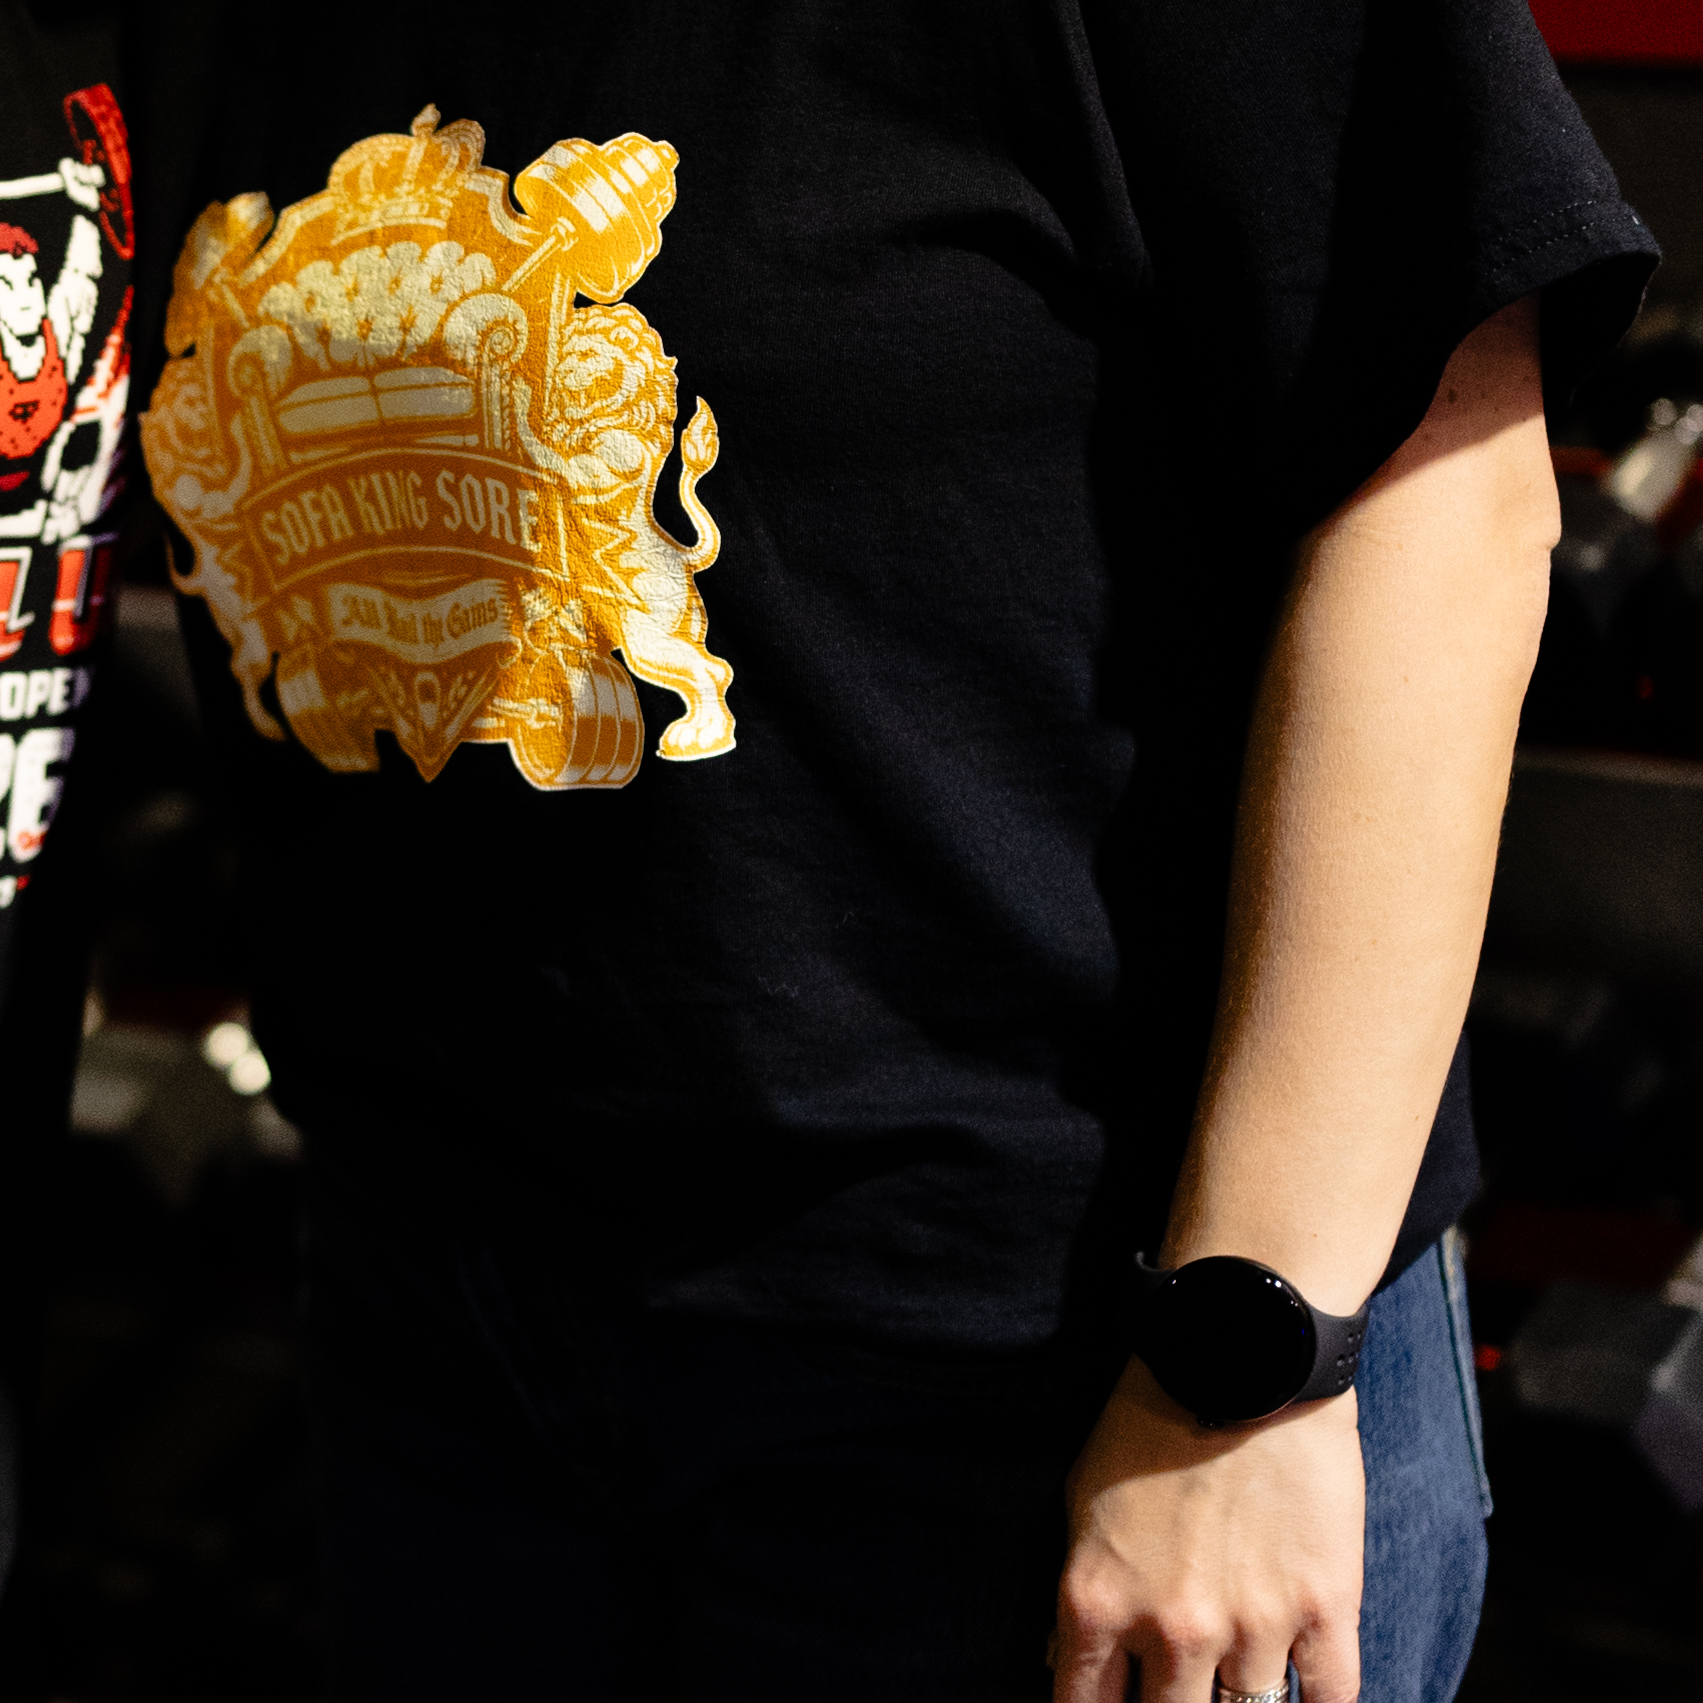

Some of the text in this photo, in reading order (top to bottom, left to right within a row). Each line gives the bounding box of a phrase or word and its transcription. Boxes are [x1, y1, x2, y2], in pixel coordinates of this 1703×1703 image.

[261, 470, 542, 566] SOFA KING SORE
